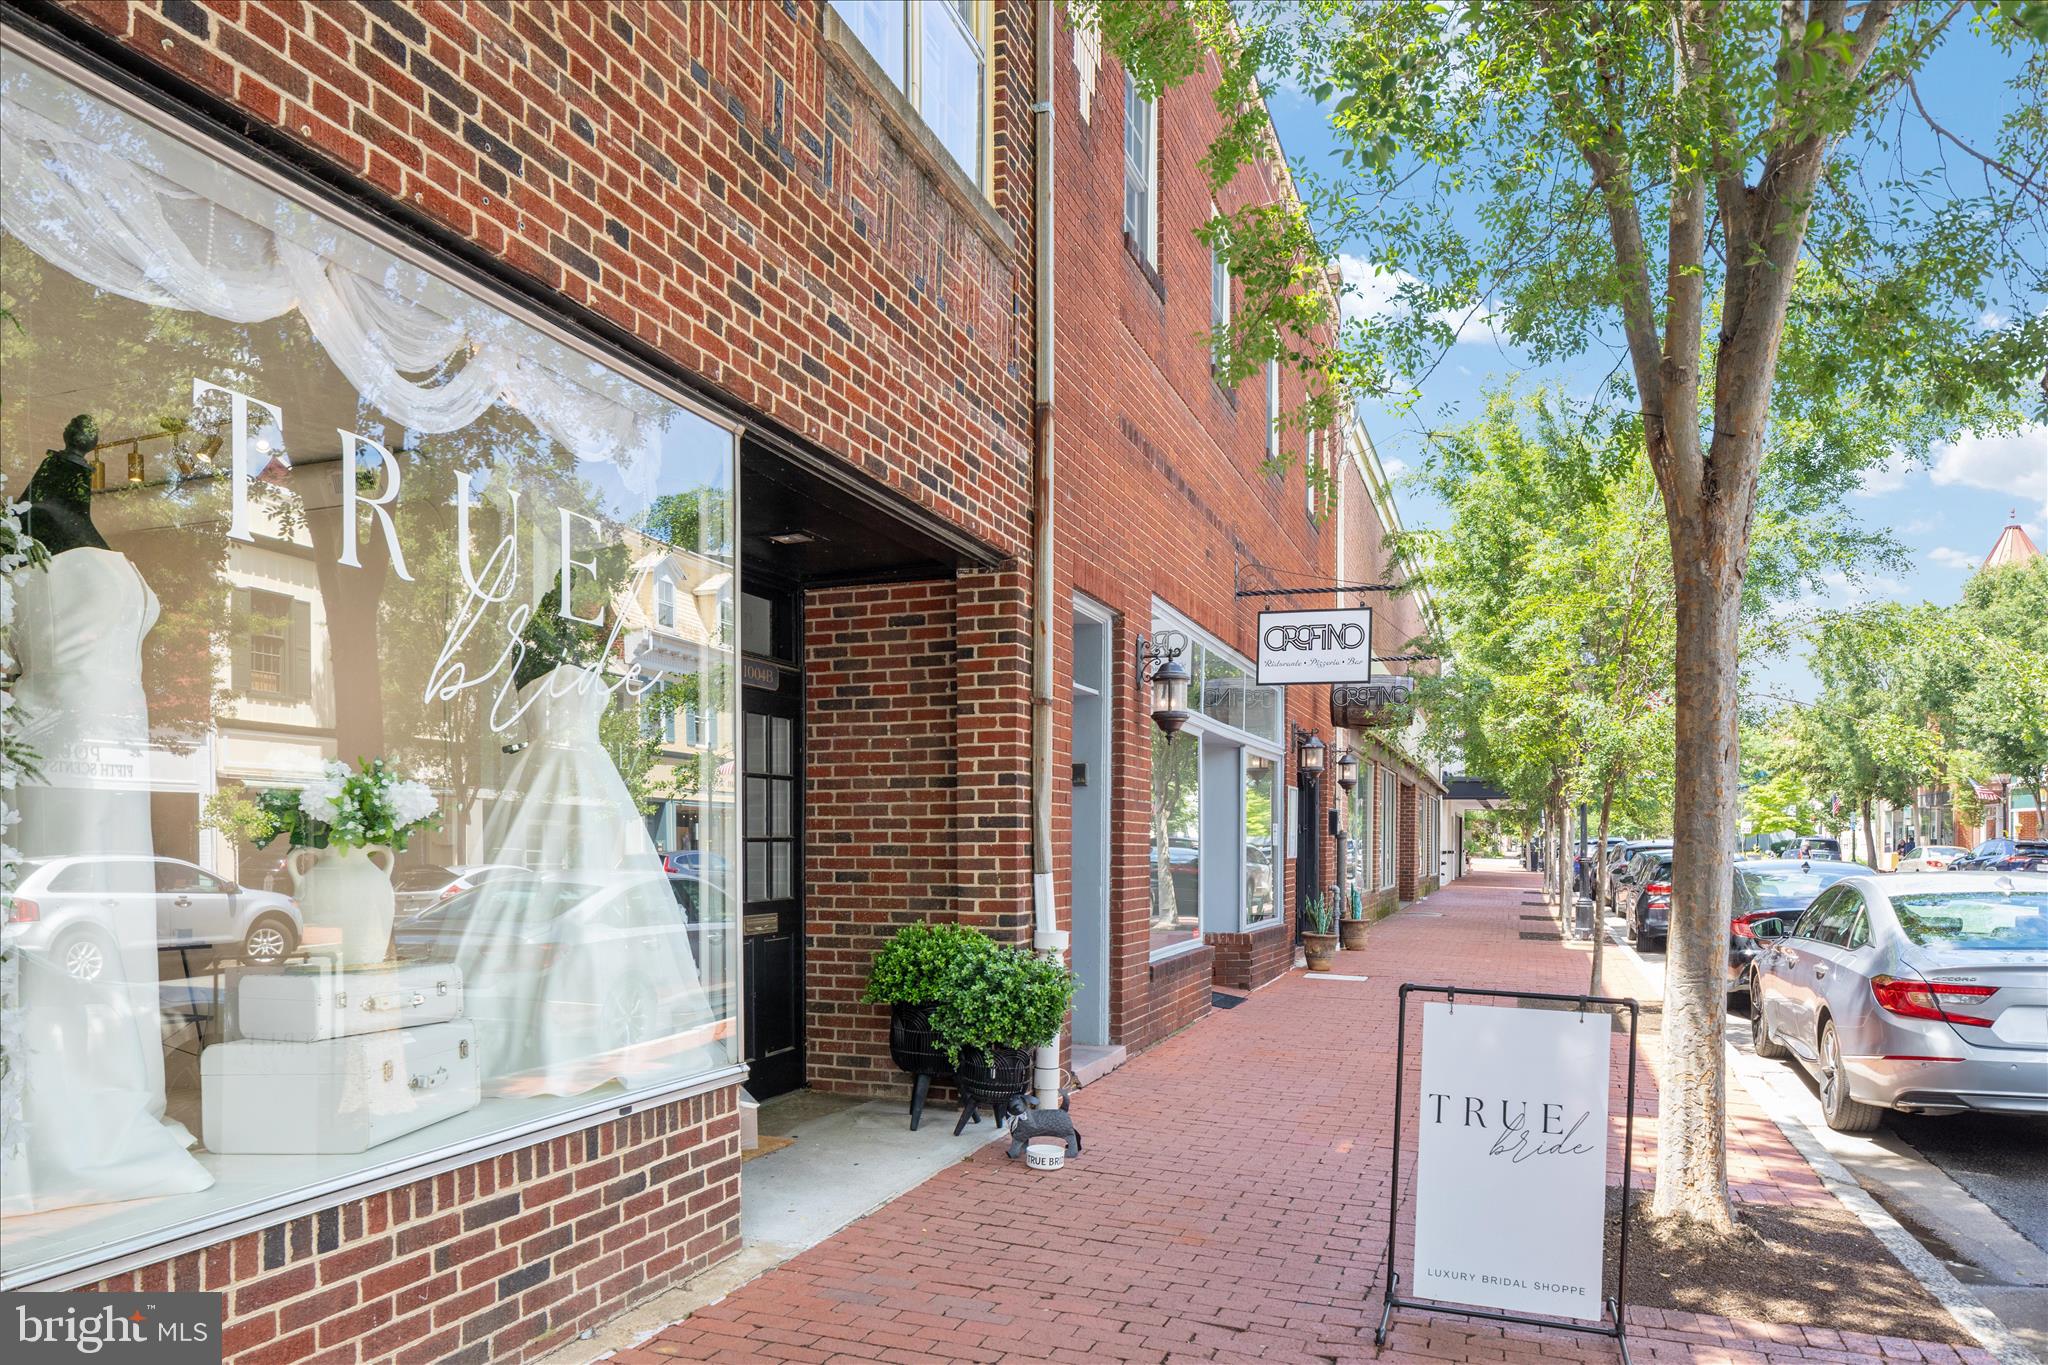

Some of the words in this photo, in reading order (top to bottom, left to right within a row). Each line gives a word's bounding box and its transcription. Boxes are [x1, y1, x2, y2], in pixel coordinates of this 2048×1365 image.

[192, 377, 606, 627] TRUE
[424, 535, 663, 732] bride
[1264, 623, 1366, 651] OROFINO
[743, 664, 774, 684] 1004B
[1310, 657, 1340, 669] Pizzeria
[1347, 656, 1364, 666] Bar
[1332, 685, 1410, 708] OROFINO
[1428, 1093, 1564, 1135] TRUE
[1489, 1111, 1594, 1163] bride
[1427, 1267, 1476, 1282] LUXURY
[1481, 1275, 1528, 1289] BRIDAL
[1533, 1281, 1586, 1296] SHOPPE
